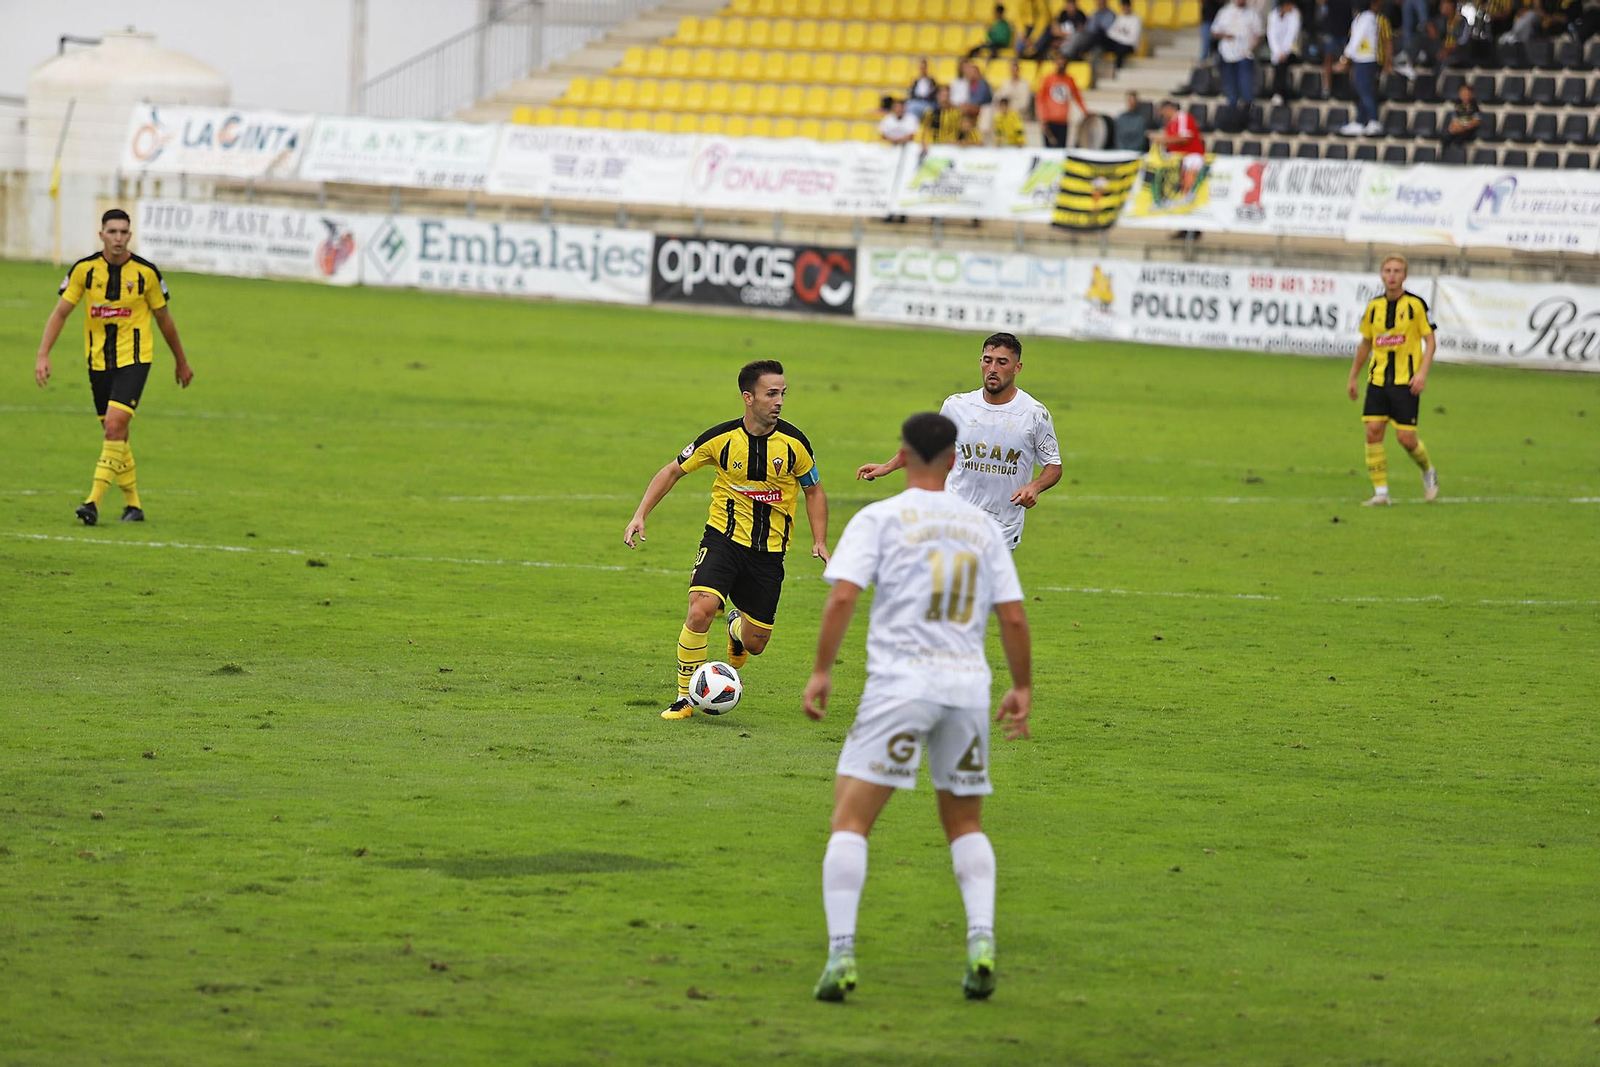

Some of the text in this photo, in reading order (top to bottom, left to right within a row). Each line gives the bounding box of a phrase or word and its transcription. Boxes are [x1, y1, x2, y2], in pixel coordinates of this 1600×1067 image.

[418, 218, 648, 282] Embalajes
[418, 269, 528, 289] HUELVA
[1131, 291, 1220, 322] POLLOS
[1230, 299, 1242, 322] Y
[1250, 299, 1339, 330] POLLAS
[961, 442, 1023, 466] UCAM
[924, 549, 978, 625] 10
